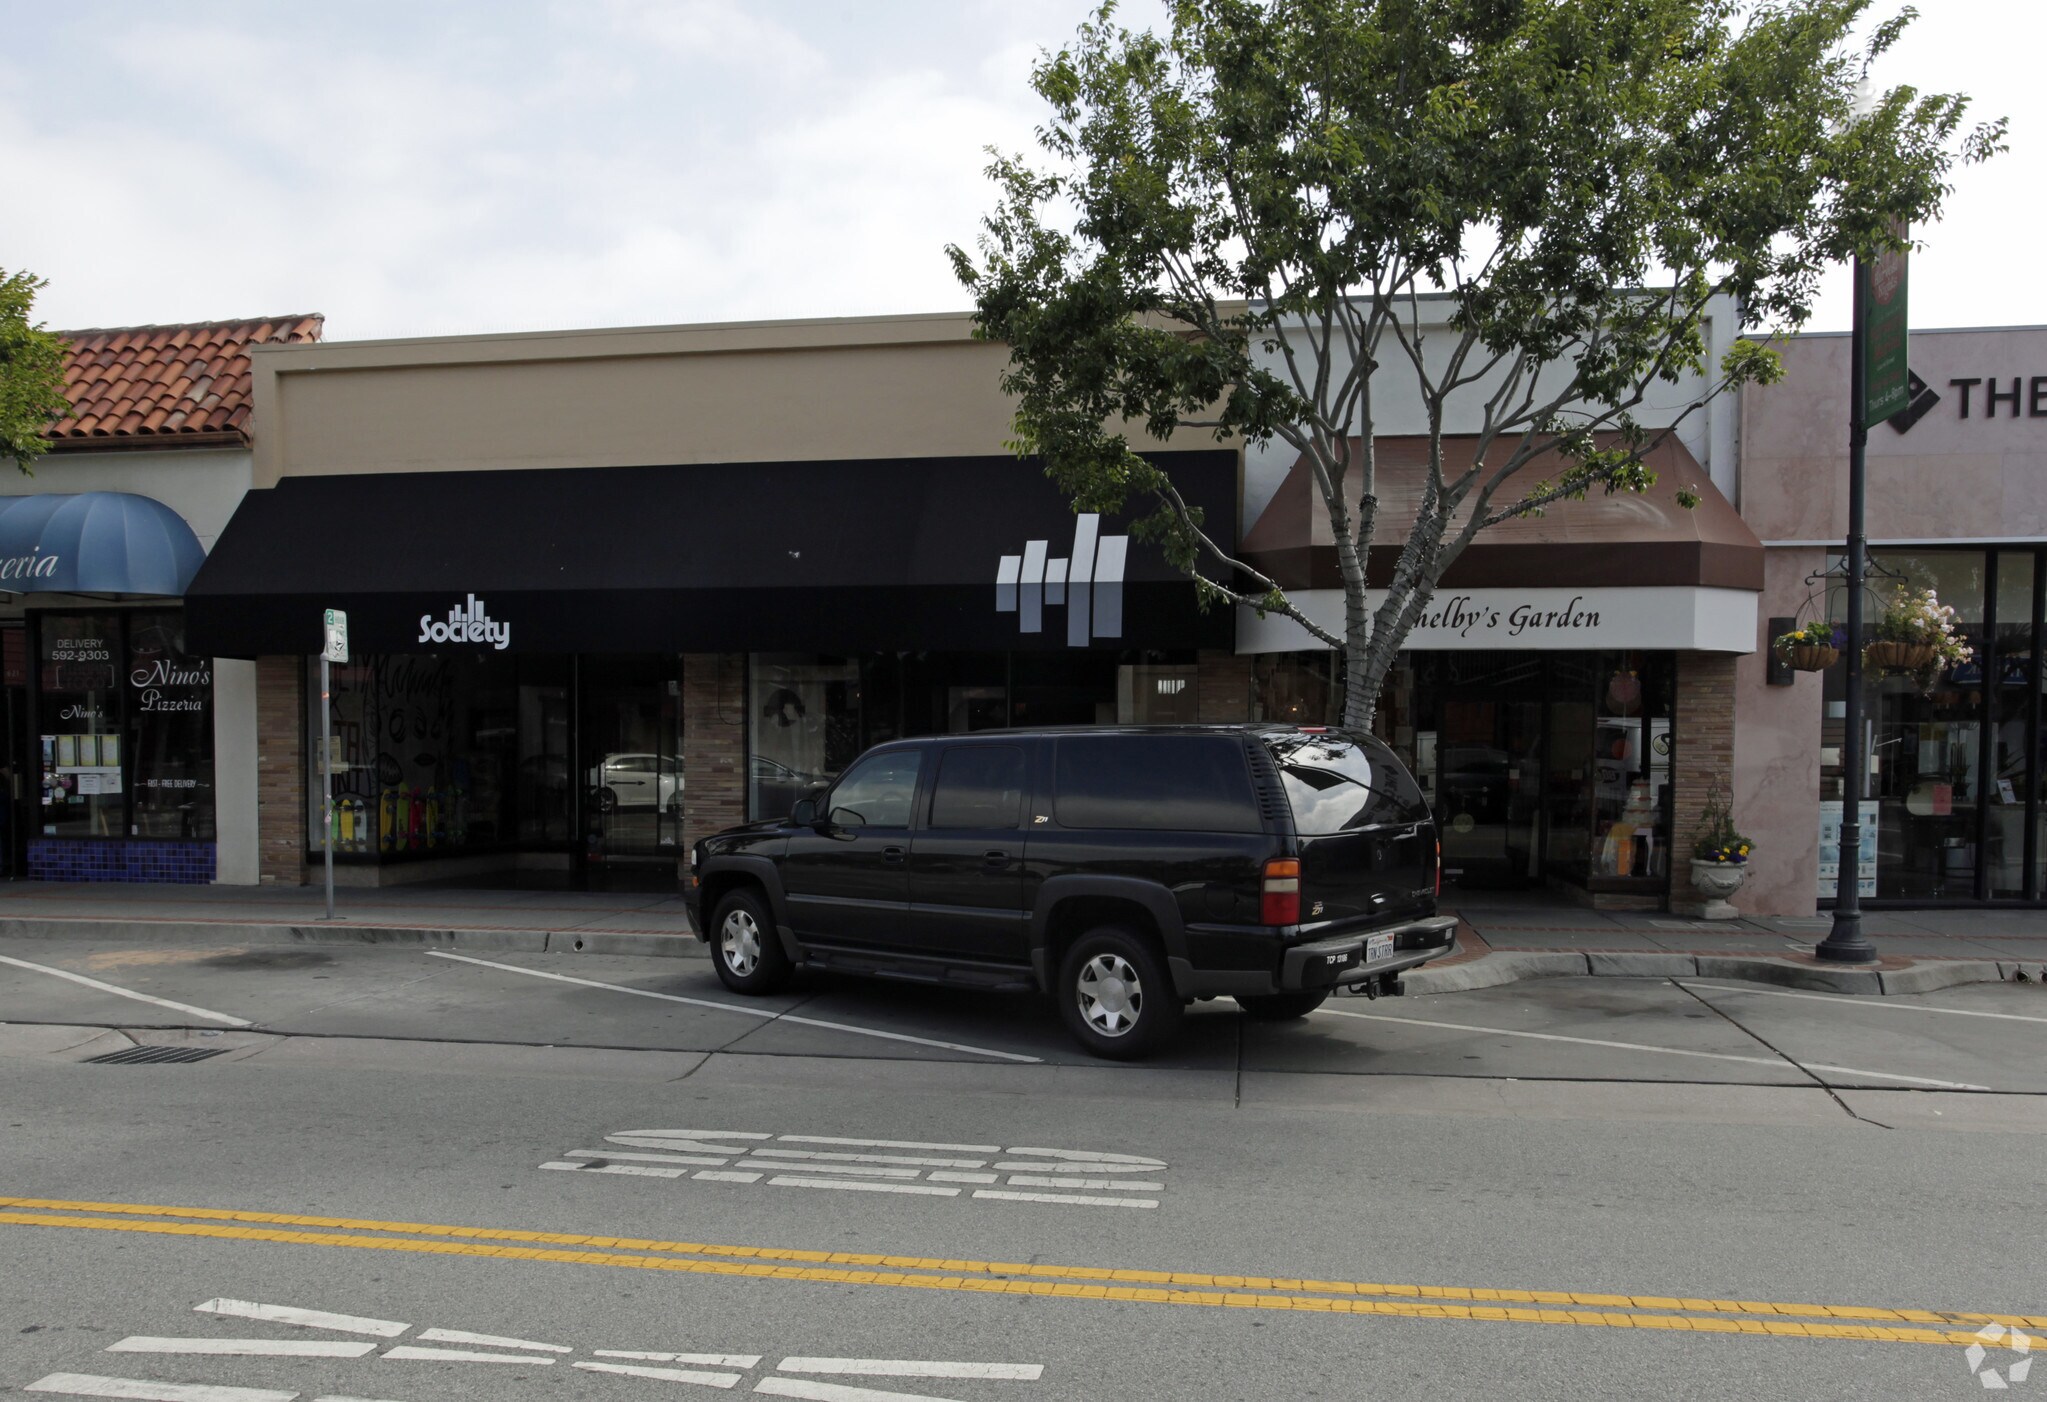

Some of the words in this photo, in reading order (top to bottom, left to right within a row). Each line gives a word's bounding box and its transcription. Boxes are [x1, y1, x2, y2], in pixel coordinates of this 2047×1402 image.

[1949, 376, 2047, 418] THE
[0, 546, 58, 579] eria
[327, 611, 334, 624] 2
[418, 593, 510, 650] Society
[1413, 596, 1500, 637] helby's
[1508, 596, 1601, 636] Garden
[51, 650, 110, 661] 592-9303
[57, 639, 103, 649] DELIVERY
[130, 659, 211, 687] Nino's
[140, 688, 202, 711] Pizzeria
[60, 704, 103, 719] Nino's
[147, 779, 158, 787] FAST
[162, 779, 173, 788] FREE
[174, 779, 197, 788] DELIVERY
